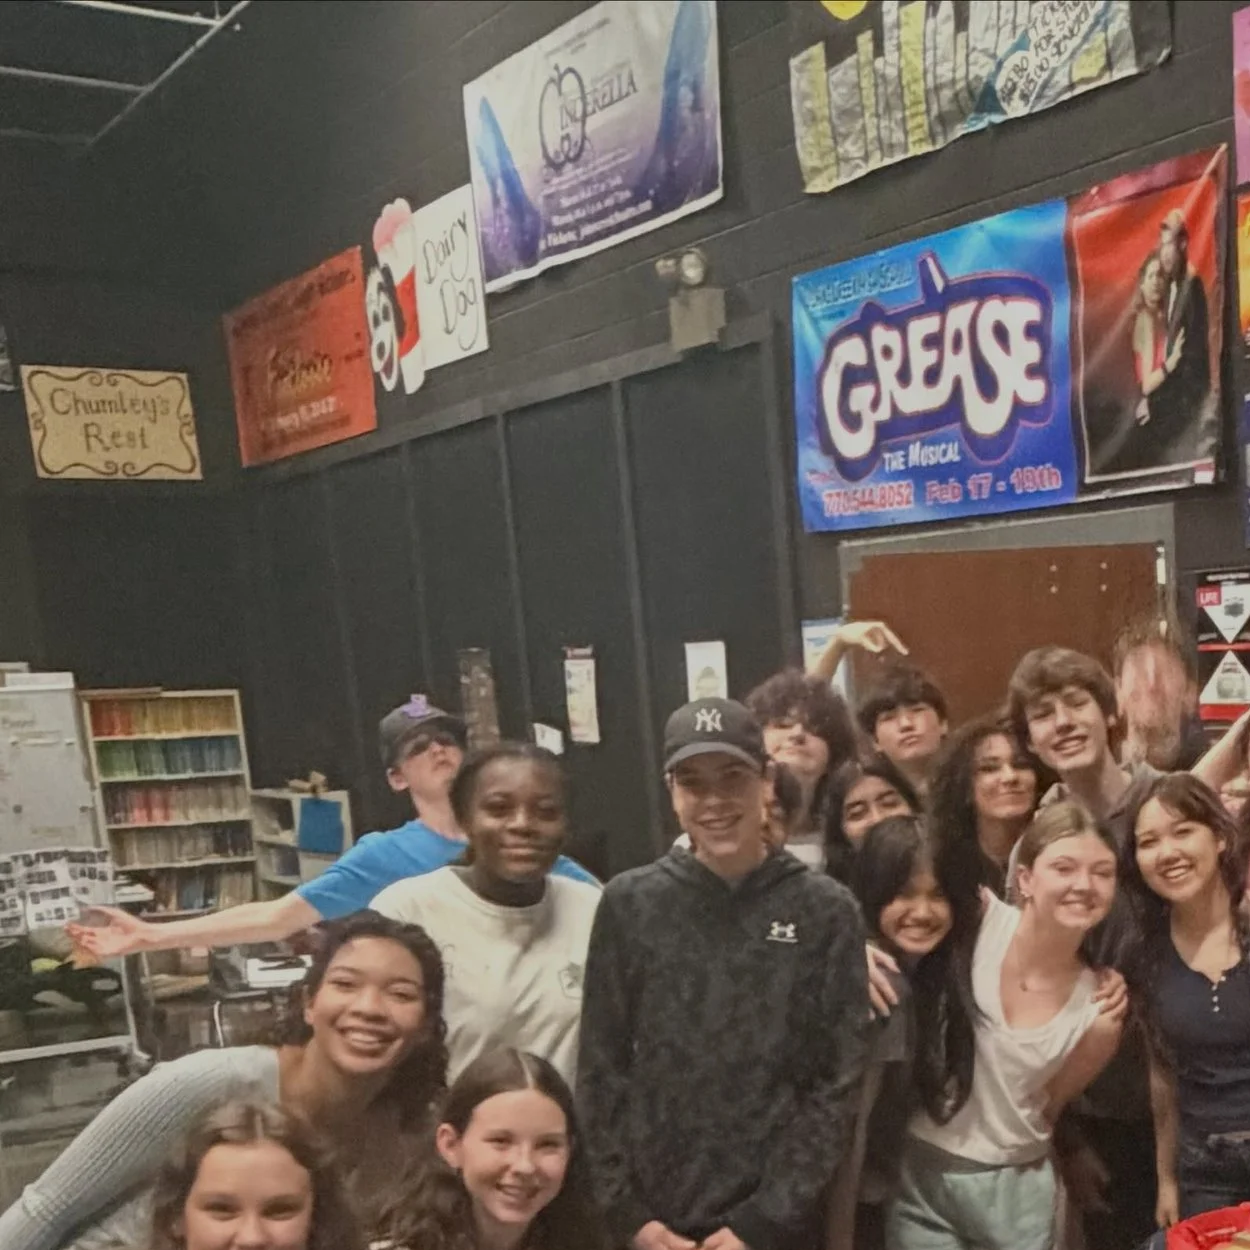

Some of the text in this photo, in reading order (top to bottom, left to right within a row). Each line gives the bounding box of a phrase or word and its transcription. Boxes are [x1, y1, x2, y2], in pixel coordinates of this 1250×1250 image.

[423, 210, 469, 284] Dairy
[440, 277, 479, 351] Dog
[49, 387, 172, 421] Chumley's
[822, 297, 1048, 460] GREASE
[84, 425, 150, 451] Rest
[926, 478, 963, 506] Feb
[967, 472, 993, 500] 17
